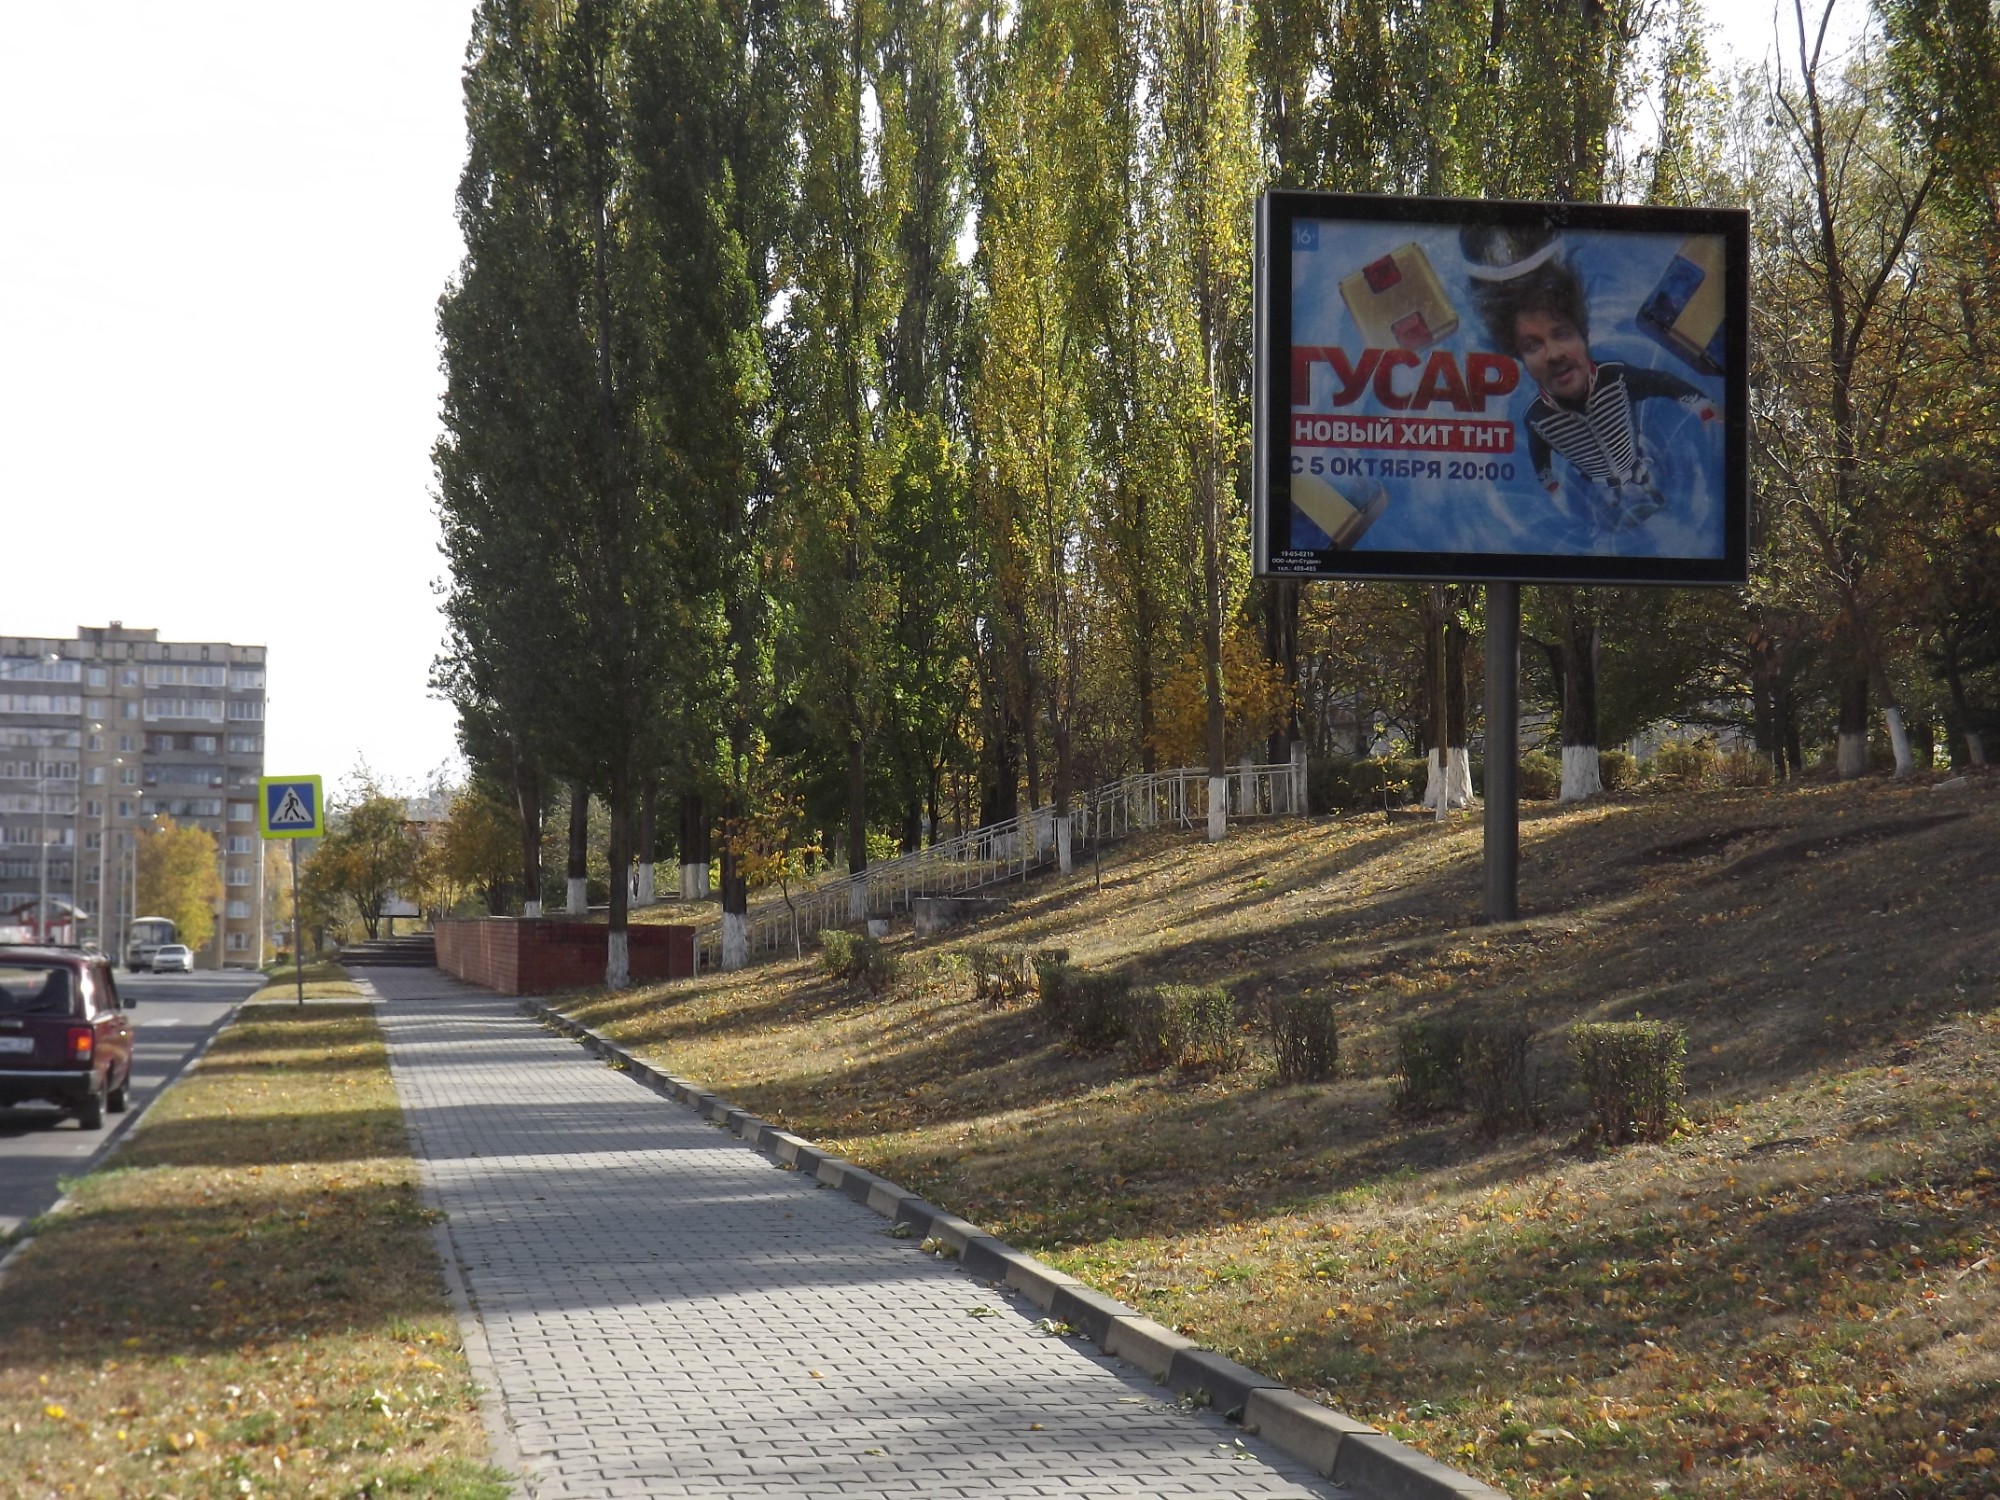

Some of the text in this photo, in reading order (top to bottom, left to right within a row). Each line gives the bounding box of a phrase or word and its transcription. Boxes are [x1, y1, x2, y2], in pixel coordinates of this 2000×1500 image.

[1291, 346, 1520, 412] ГУСАР
[1295, 418, 1510, 448] НОВЫЙ ХИТ ТНТ
[1290, 455, 1516, 481] С 5 ОКТЯБРЯ 20:00
